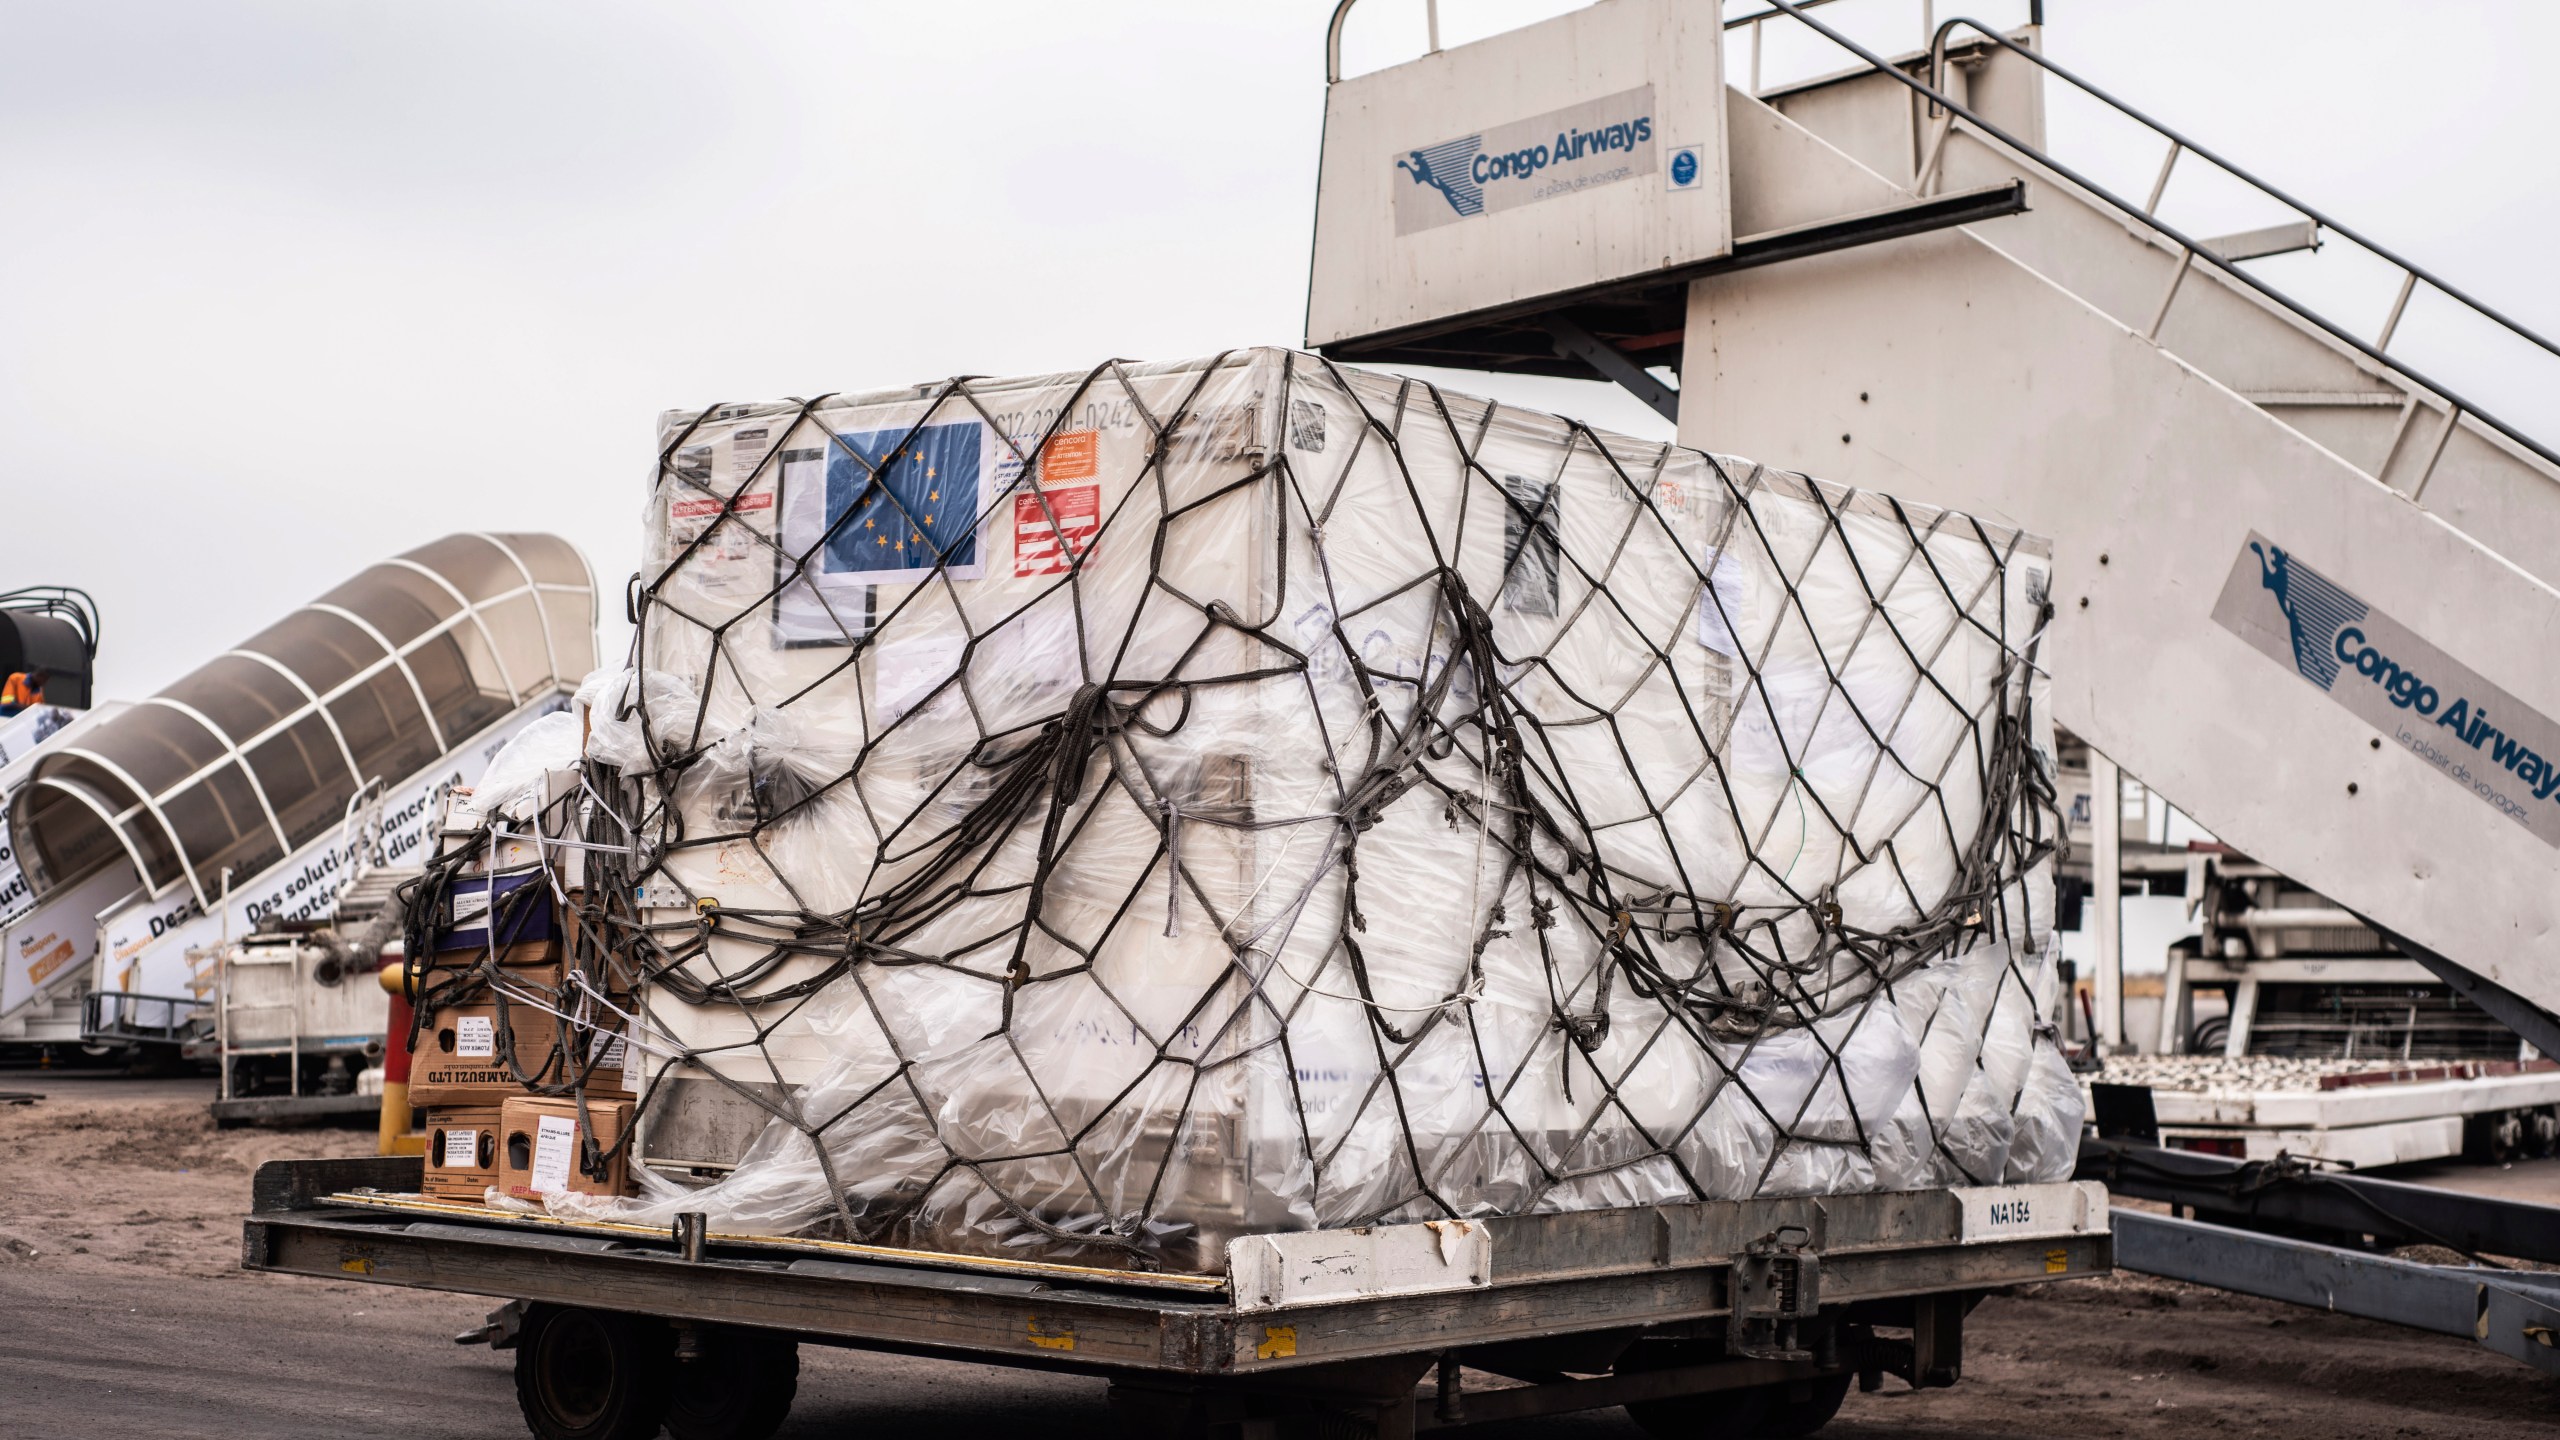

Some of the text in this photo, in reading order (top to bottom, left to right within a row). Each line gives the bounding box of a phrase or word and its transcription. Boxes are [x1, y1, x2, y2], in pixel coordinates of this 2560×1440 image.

[1472, 116, 1652, 185] Congo Airways
[1054, 435, 1086, 446] cencora
[1056, 451, 1083, 459] ATTENTION
[2335, 627, 2439, 716] Congo
[2395, 723, 2411, 743] Le
[2411, 735, 2450, 770] plaisir
[2452, 763, 2471, 784] de
[245, 890, 283, 924] Des
[428, 1071, 517, 1083] TAMBUZI LTD
[1990, 1200, 2030, 1226] NA156
